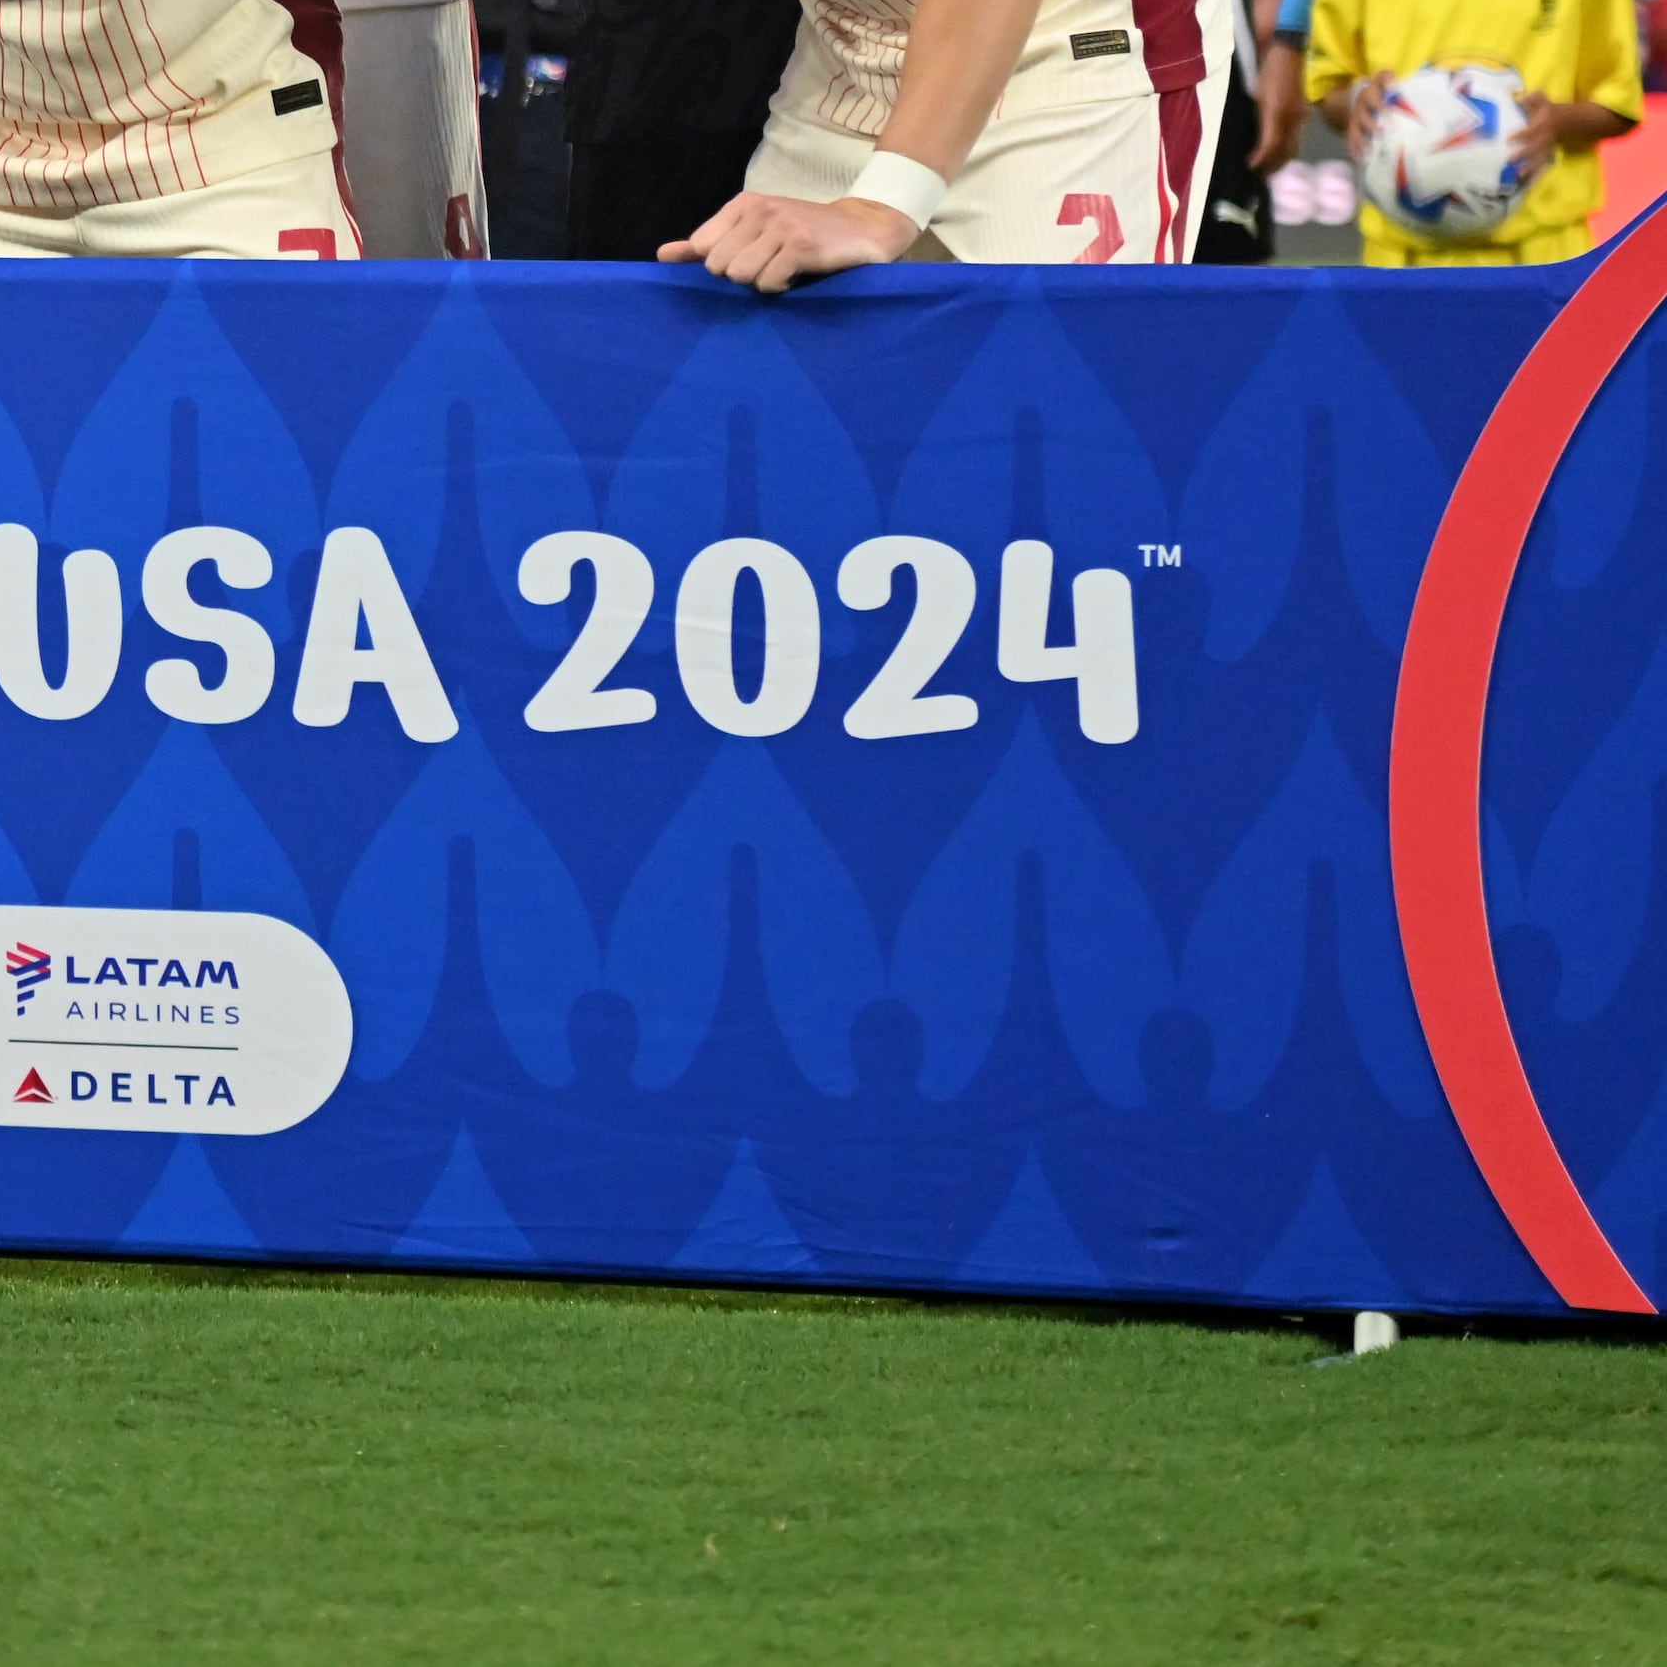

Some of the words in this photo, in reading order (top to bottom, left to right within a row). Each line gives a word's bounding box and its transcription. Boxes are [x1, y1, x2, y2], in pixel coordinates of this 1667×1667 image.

[518, 531, 1140, 745] 2024
[66, 955, 240, 990] LATAM
[66, 1000, 241, 1025] AIRLINES
[70, 1070, 236, 1107] DELTA
